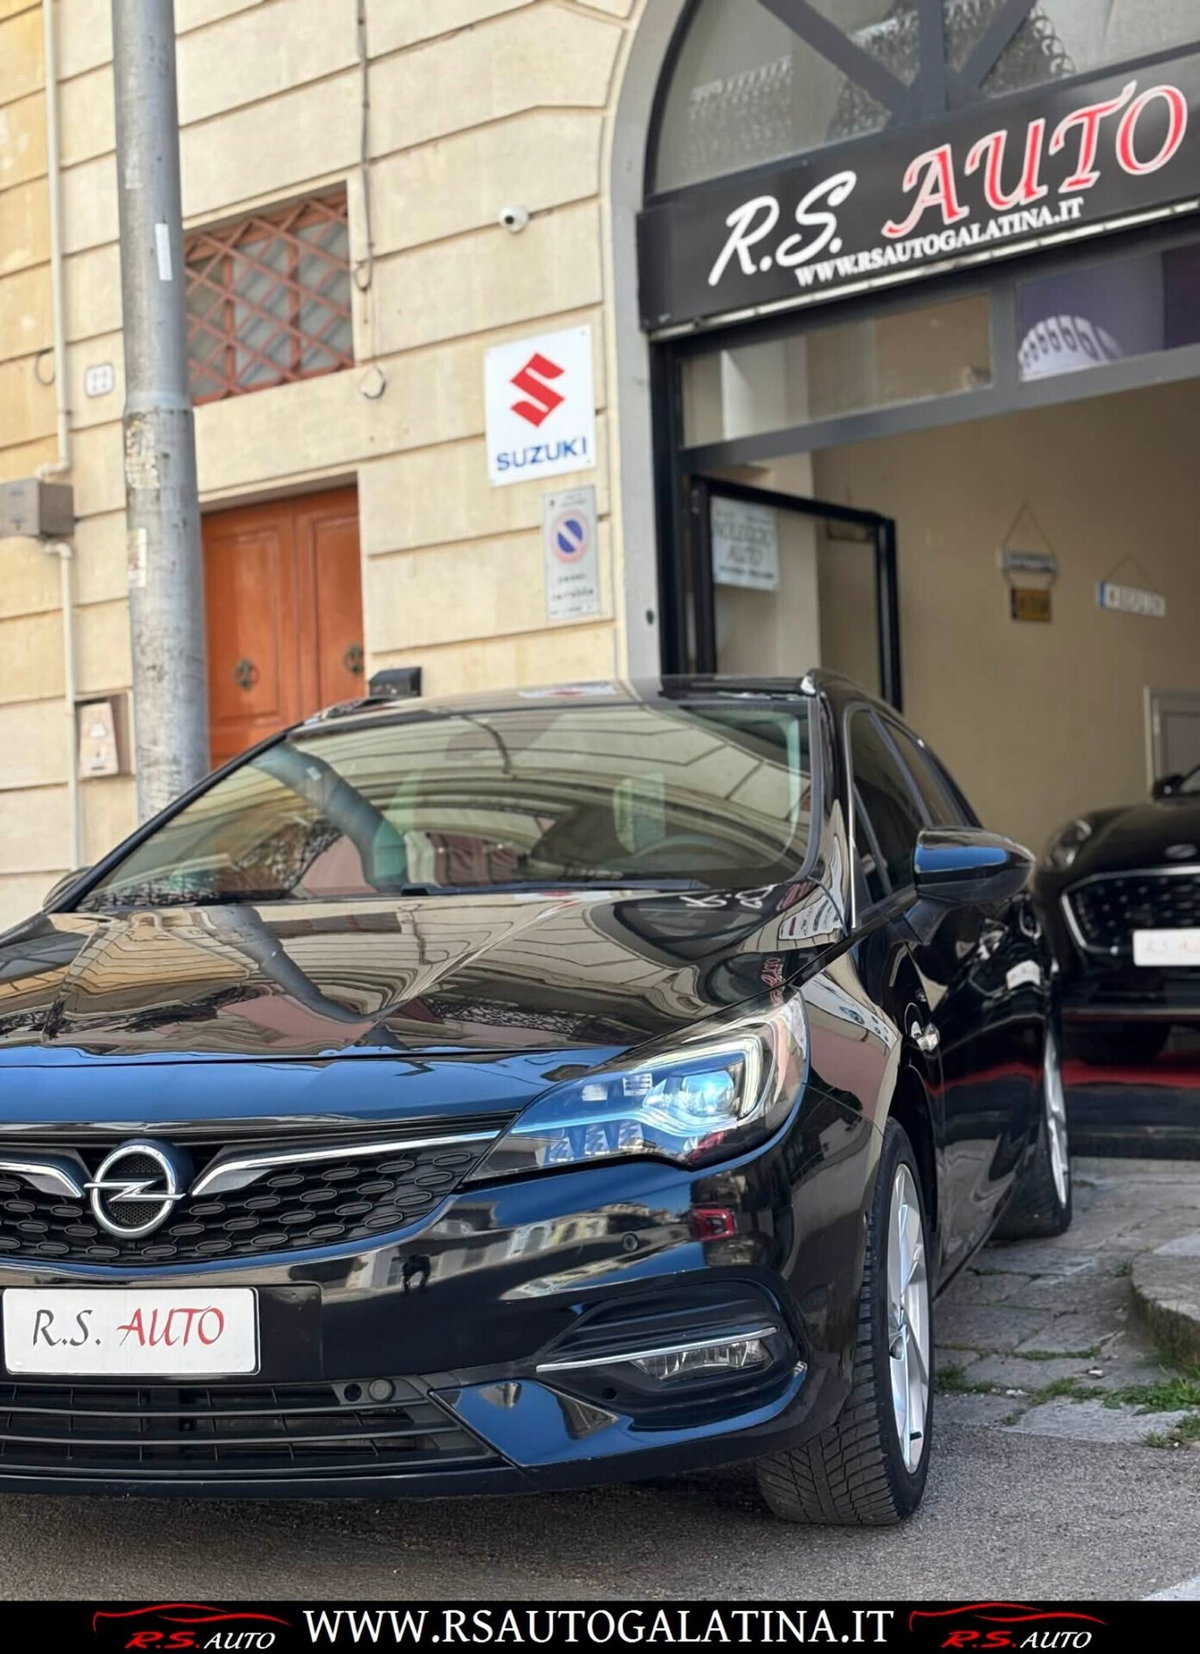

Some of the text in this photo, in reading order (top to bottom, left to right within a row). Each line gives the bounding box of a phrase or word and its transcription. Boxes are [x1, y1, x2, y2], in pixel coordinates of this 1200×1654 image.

[708, 79, 1189, 286] R.S. AUTO
[794, 197, 1085, 288] WWW.RSAUTOGALATINA.IT
[496, 437, 588, 471] SUZUKI
[32, 1306, 225, 1347] R.S. AUTO
